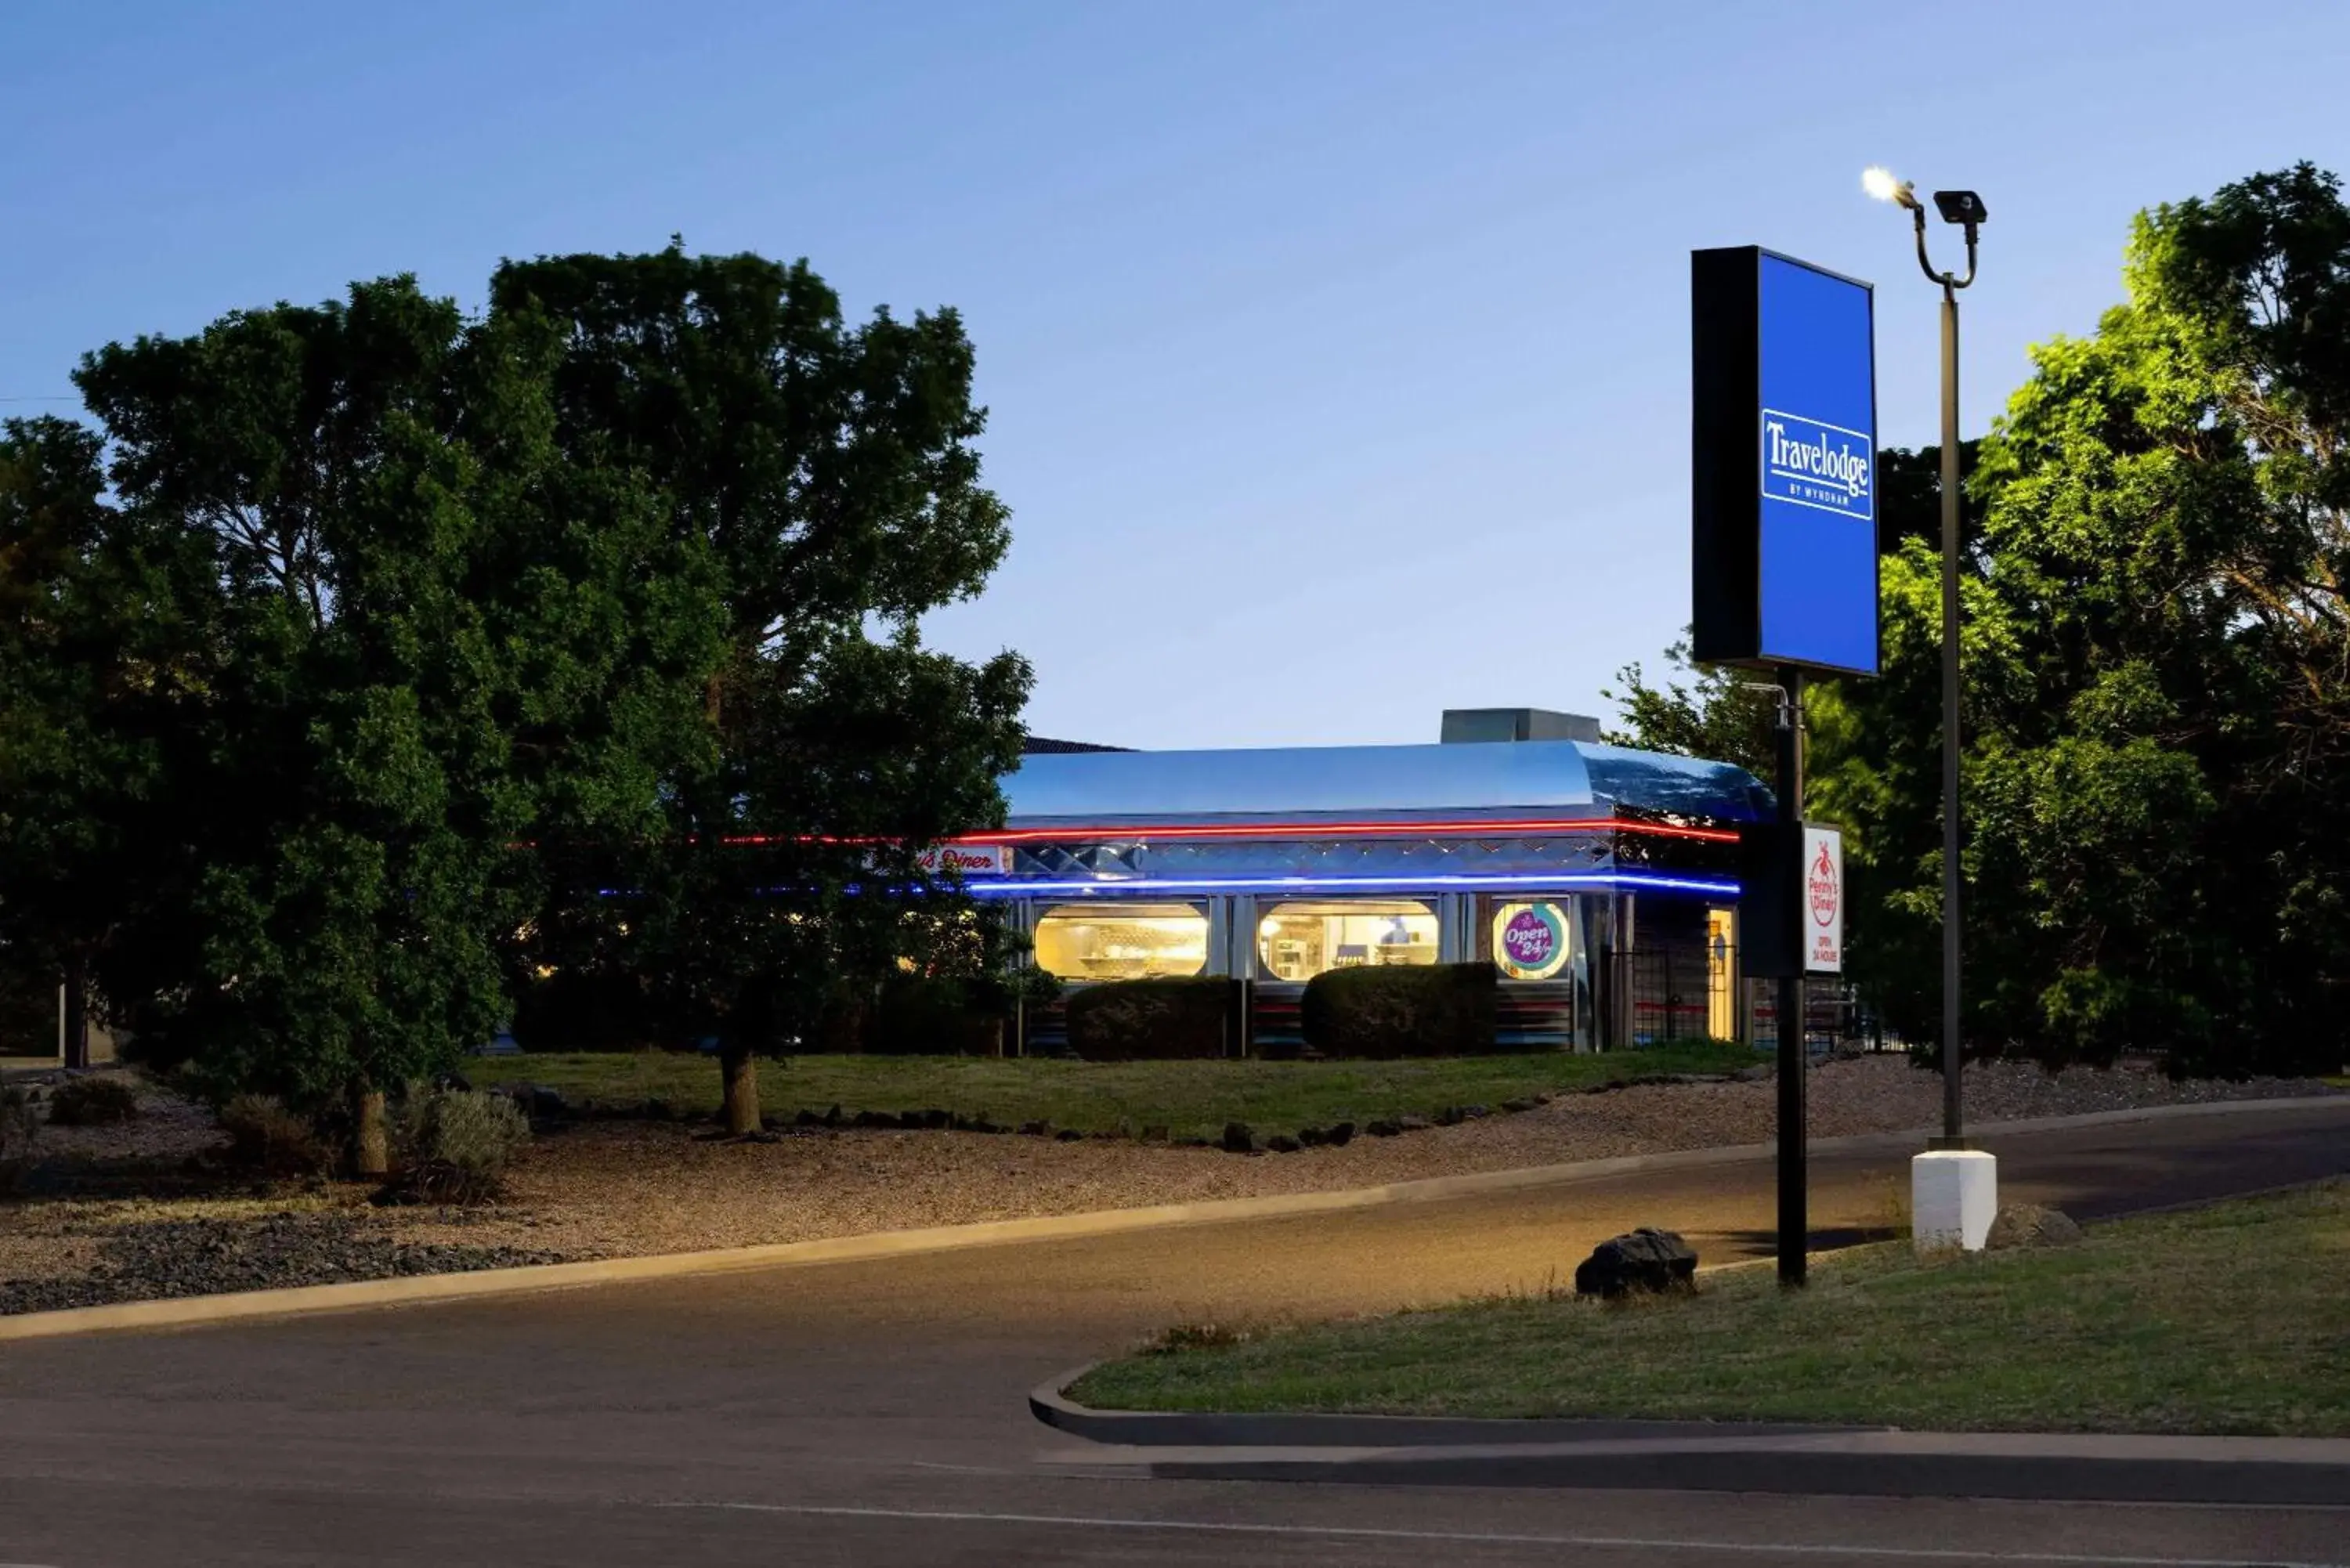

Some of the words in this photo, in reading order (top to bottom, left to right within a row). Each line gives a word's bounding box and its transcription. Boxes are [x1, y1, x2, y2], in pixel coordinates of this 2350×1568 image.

[1766, 421, 1868, 497] Travelodge
[1790, 482, 1801, 496] BY
[942, 850, 994, 869] Diner
[1506, 927, 1549, 945] Open
